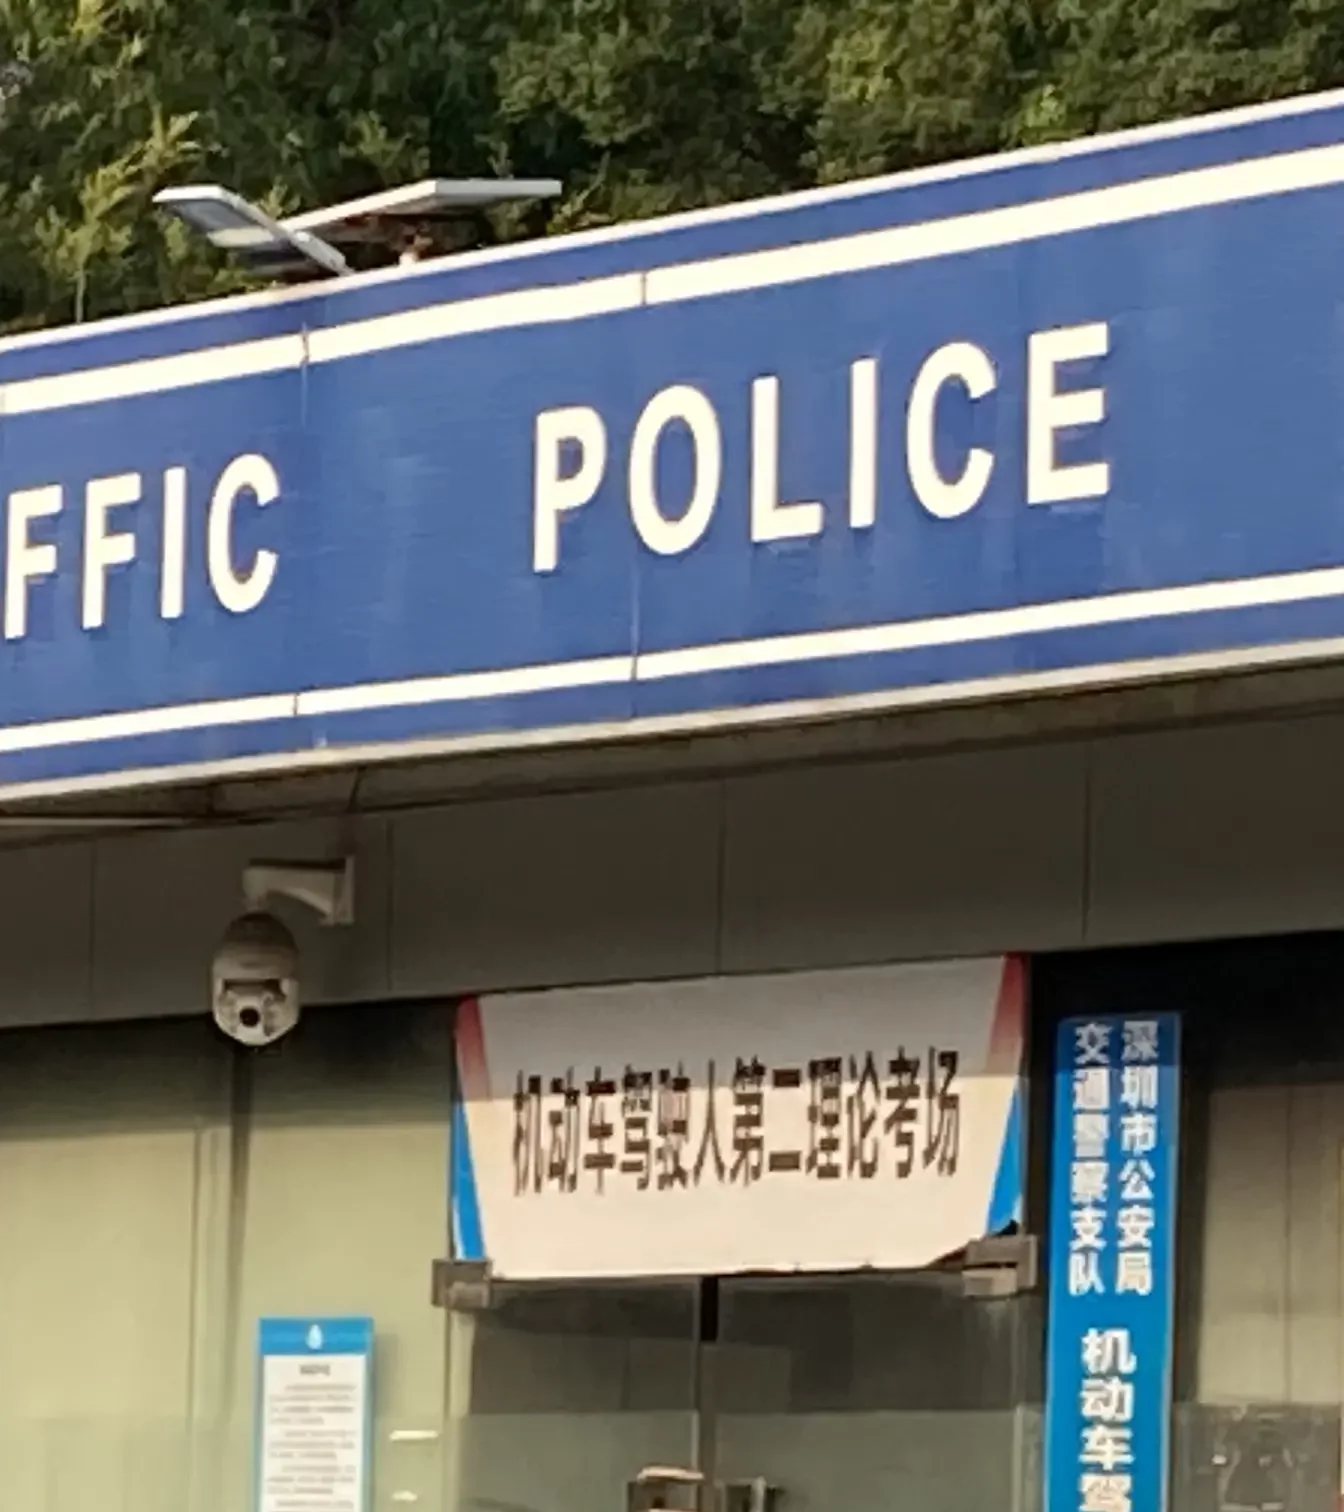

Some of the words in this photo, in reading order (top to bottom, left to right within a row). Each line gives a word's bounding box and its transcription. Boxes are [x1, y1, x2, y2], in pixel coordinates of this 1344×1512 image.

[532, 322, 1111, 573] POLICE
[513, 1046, 961, 1195] 机动车驾驶人第二理论考场
[1114, 1020, 1159, 1296] 深圳市公安局
